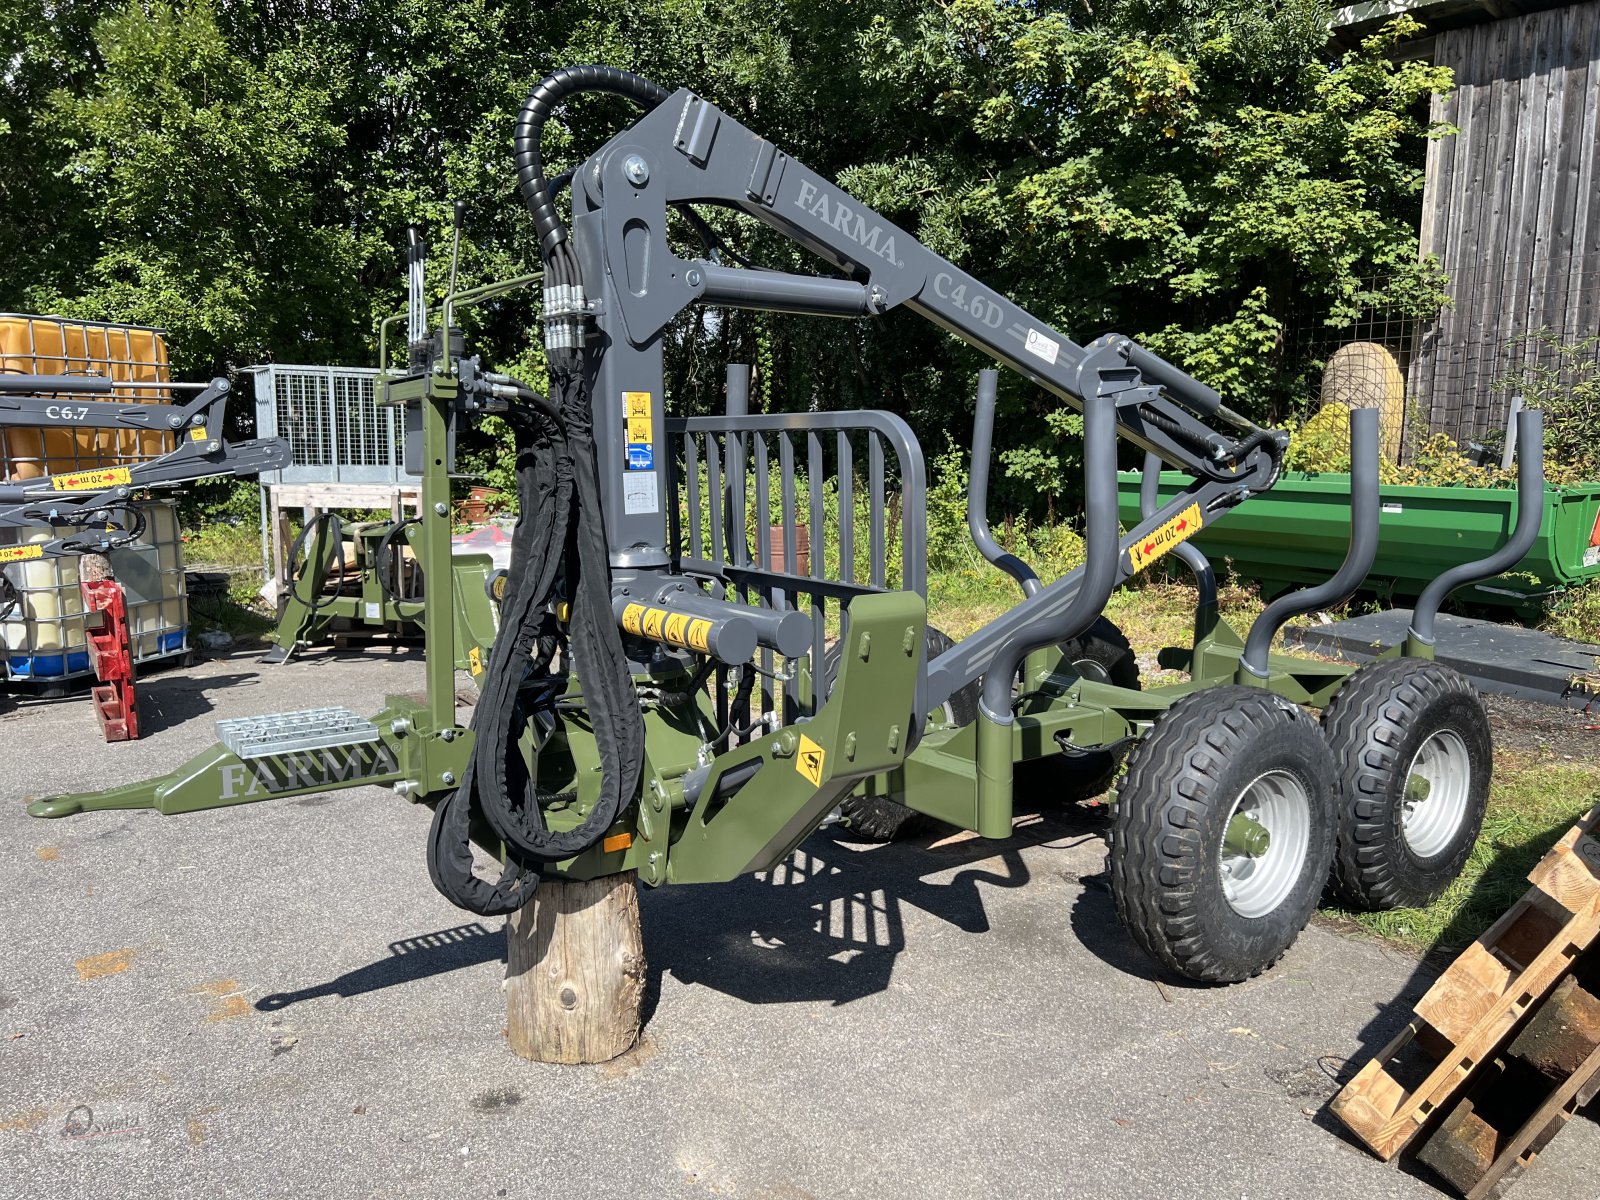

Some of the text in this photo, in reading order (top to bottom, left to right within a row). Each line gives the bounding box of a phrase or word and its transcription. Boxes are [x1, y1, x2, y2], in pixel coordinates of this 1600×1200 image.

[933, 272, 1004, 329] C4.6D
[45, 405, 89, 420] C6.7
[91, 474, 103, 484] 20
[1165, 525, 1176, 541] 20
